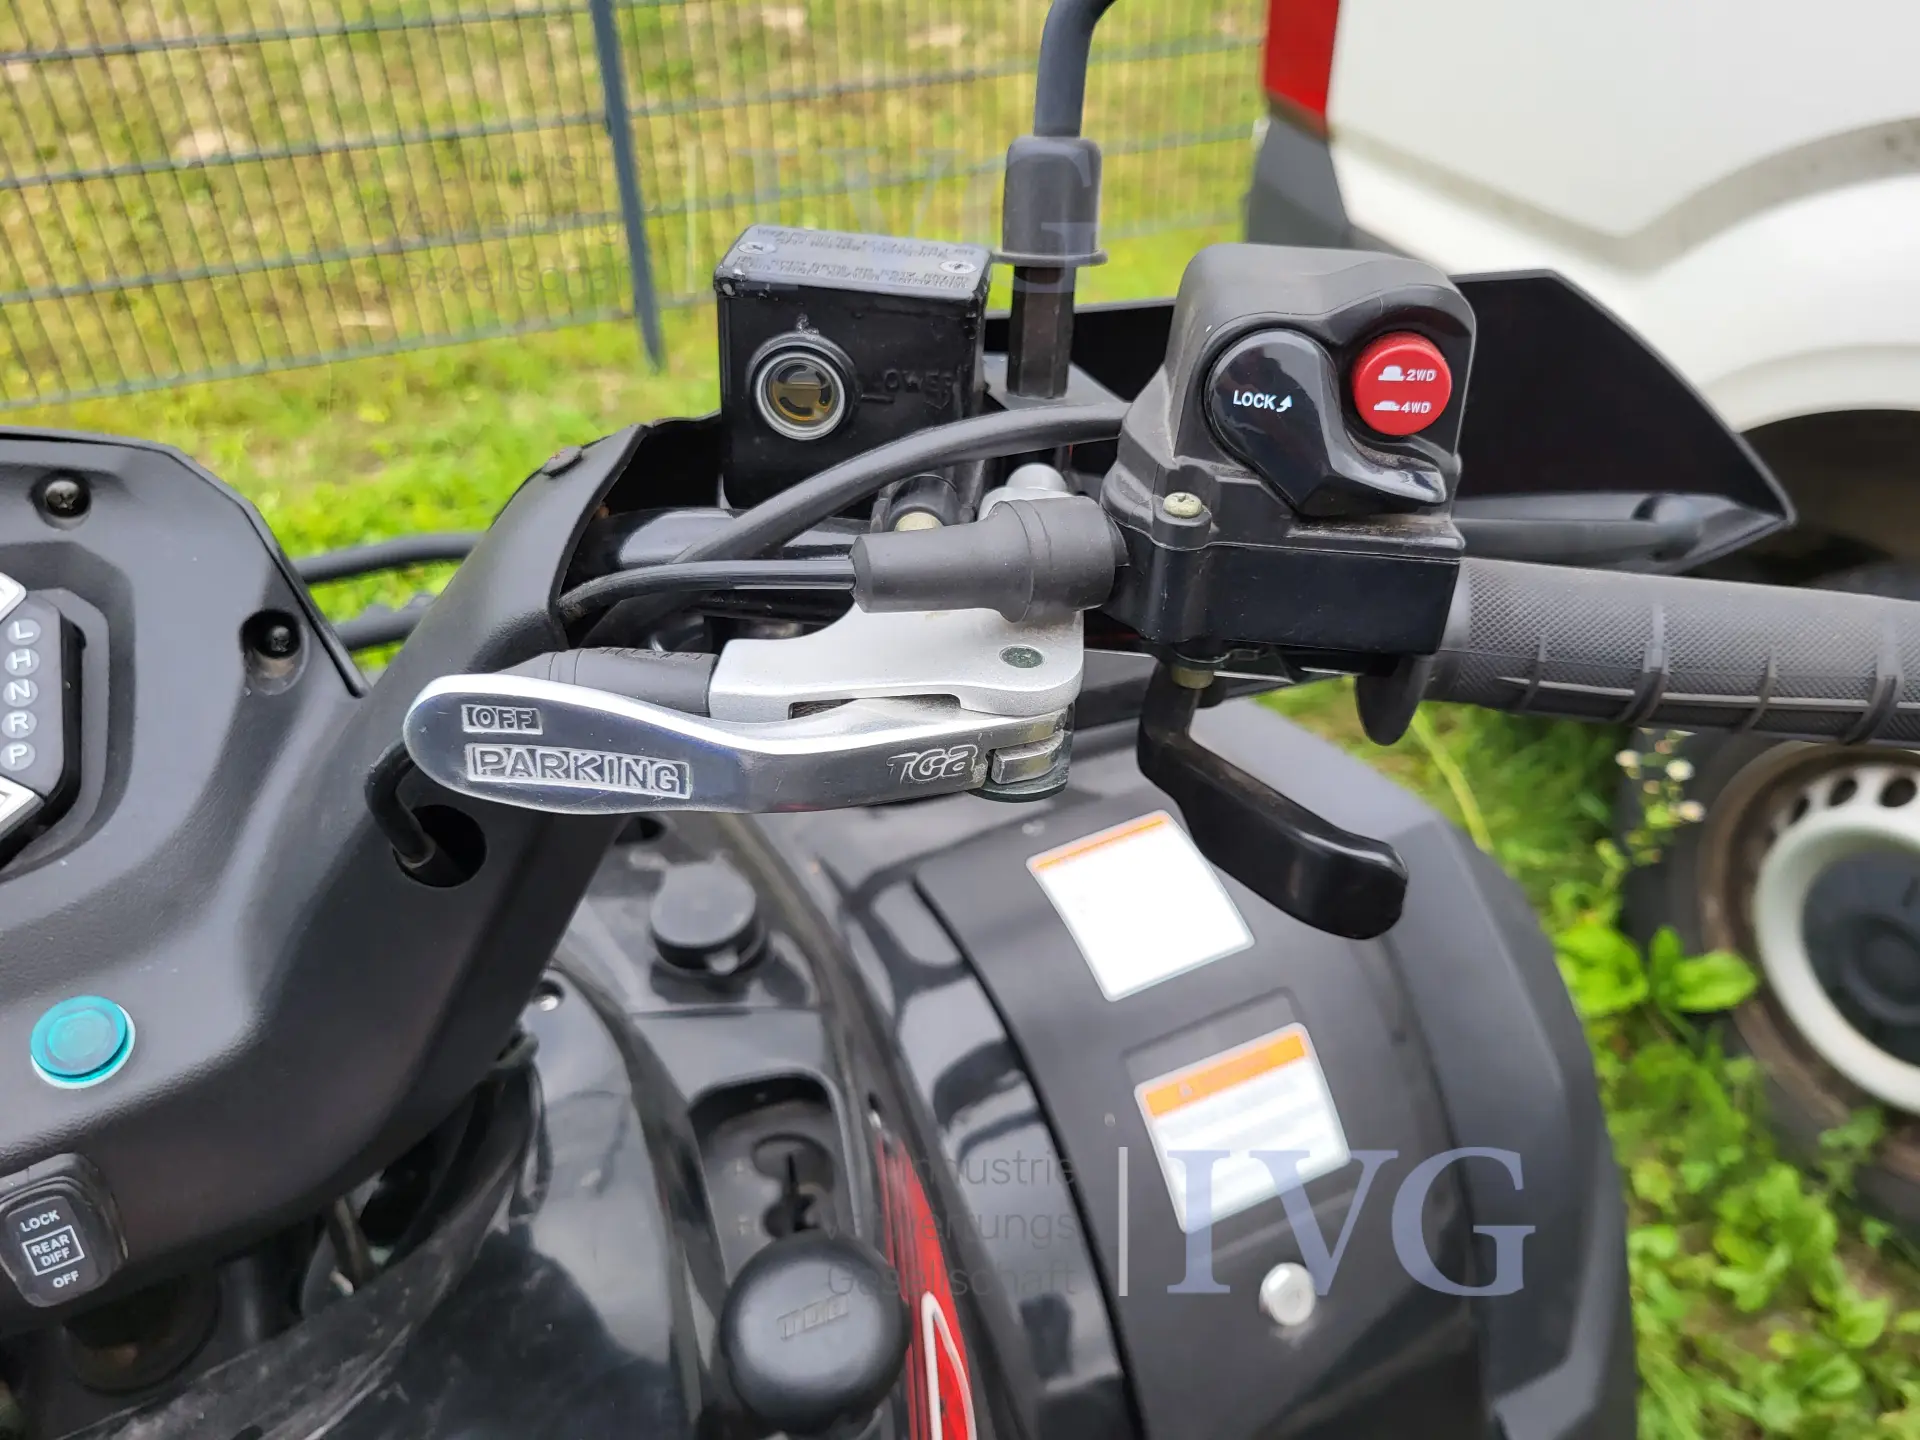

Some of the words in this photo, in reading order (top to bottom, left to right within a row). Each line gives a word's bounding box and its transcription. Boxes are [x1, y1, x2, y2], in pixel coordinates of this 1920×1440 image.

[1406, 368, 1437, 382] 2WD
[1233, 390, 1278, 411] LOCK
[1400, 401, 1432, 414] 4WD
[14, 620, 34, 640] L
[11, 648, 32, 670] H
[8, 678, 31, 701] N
[8, 715, 30, 732] R
[472, 706, 534, 730] OFF
[8, 746, 28, 766] P
[474, 746, 681, 796] PARKING
[20, 1210, 60, 1232] LOCK
[31, 1235, 70, 1256] REAR
[41, 1247, 70, 1267] DIFF
[53, 1271, 79, 1288] OFF
